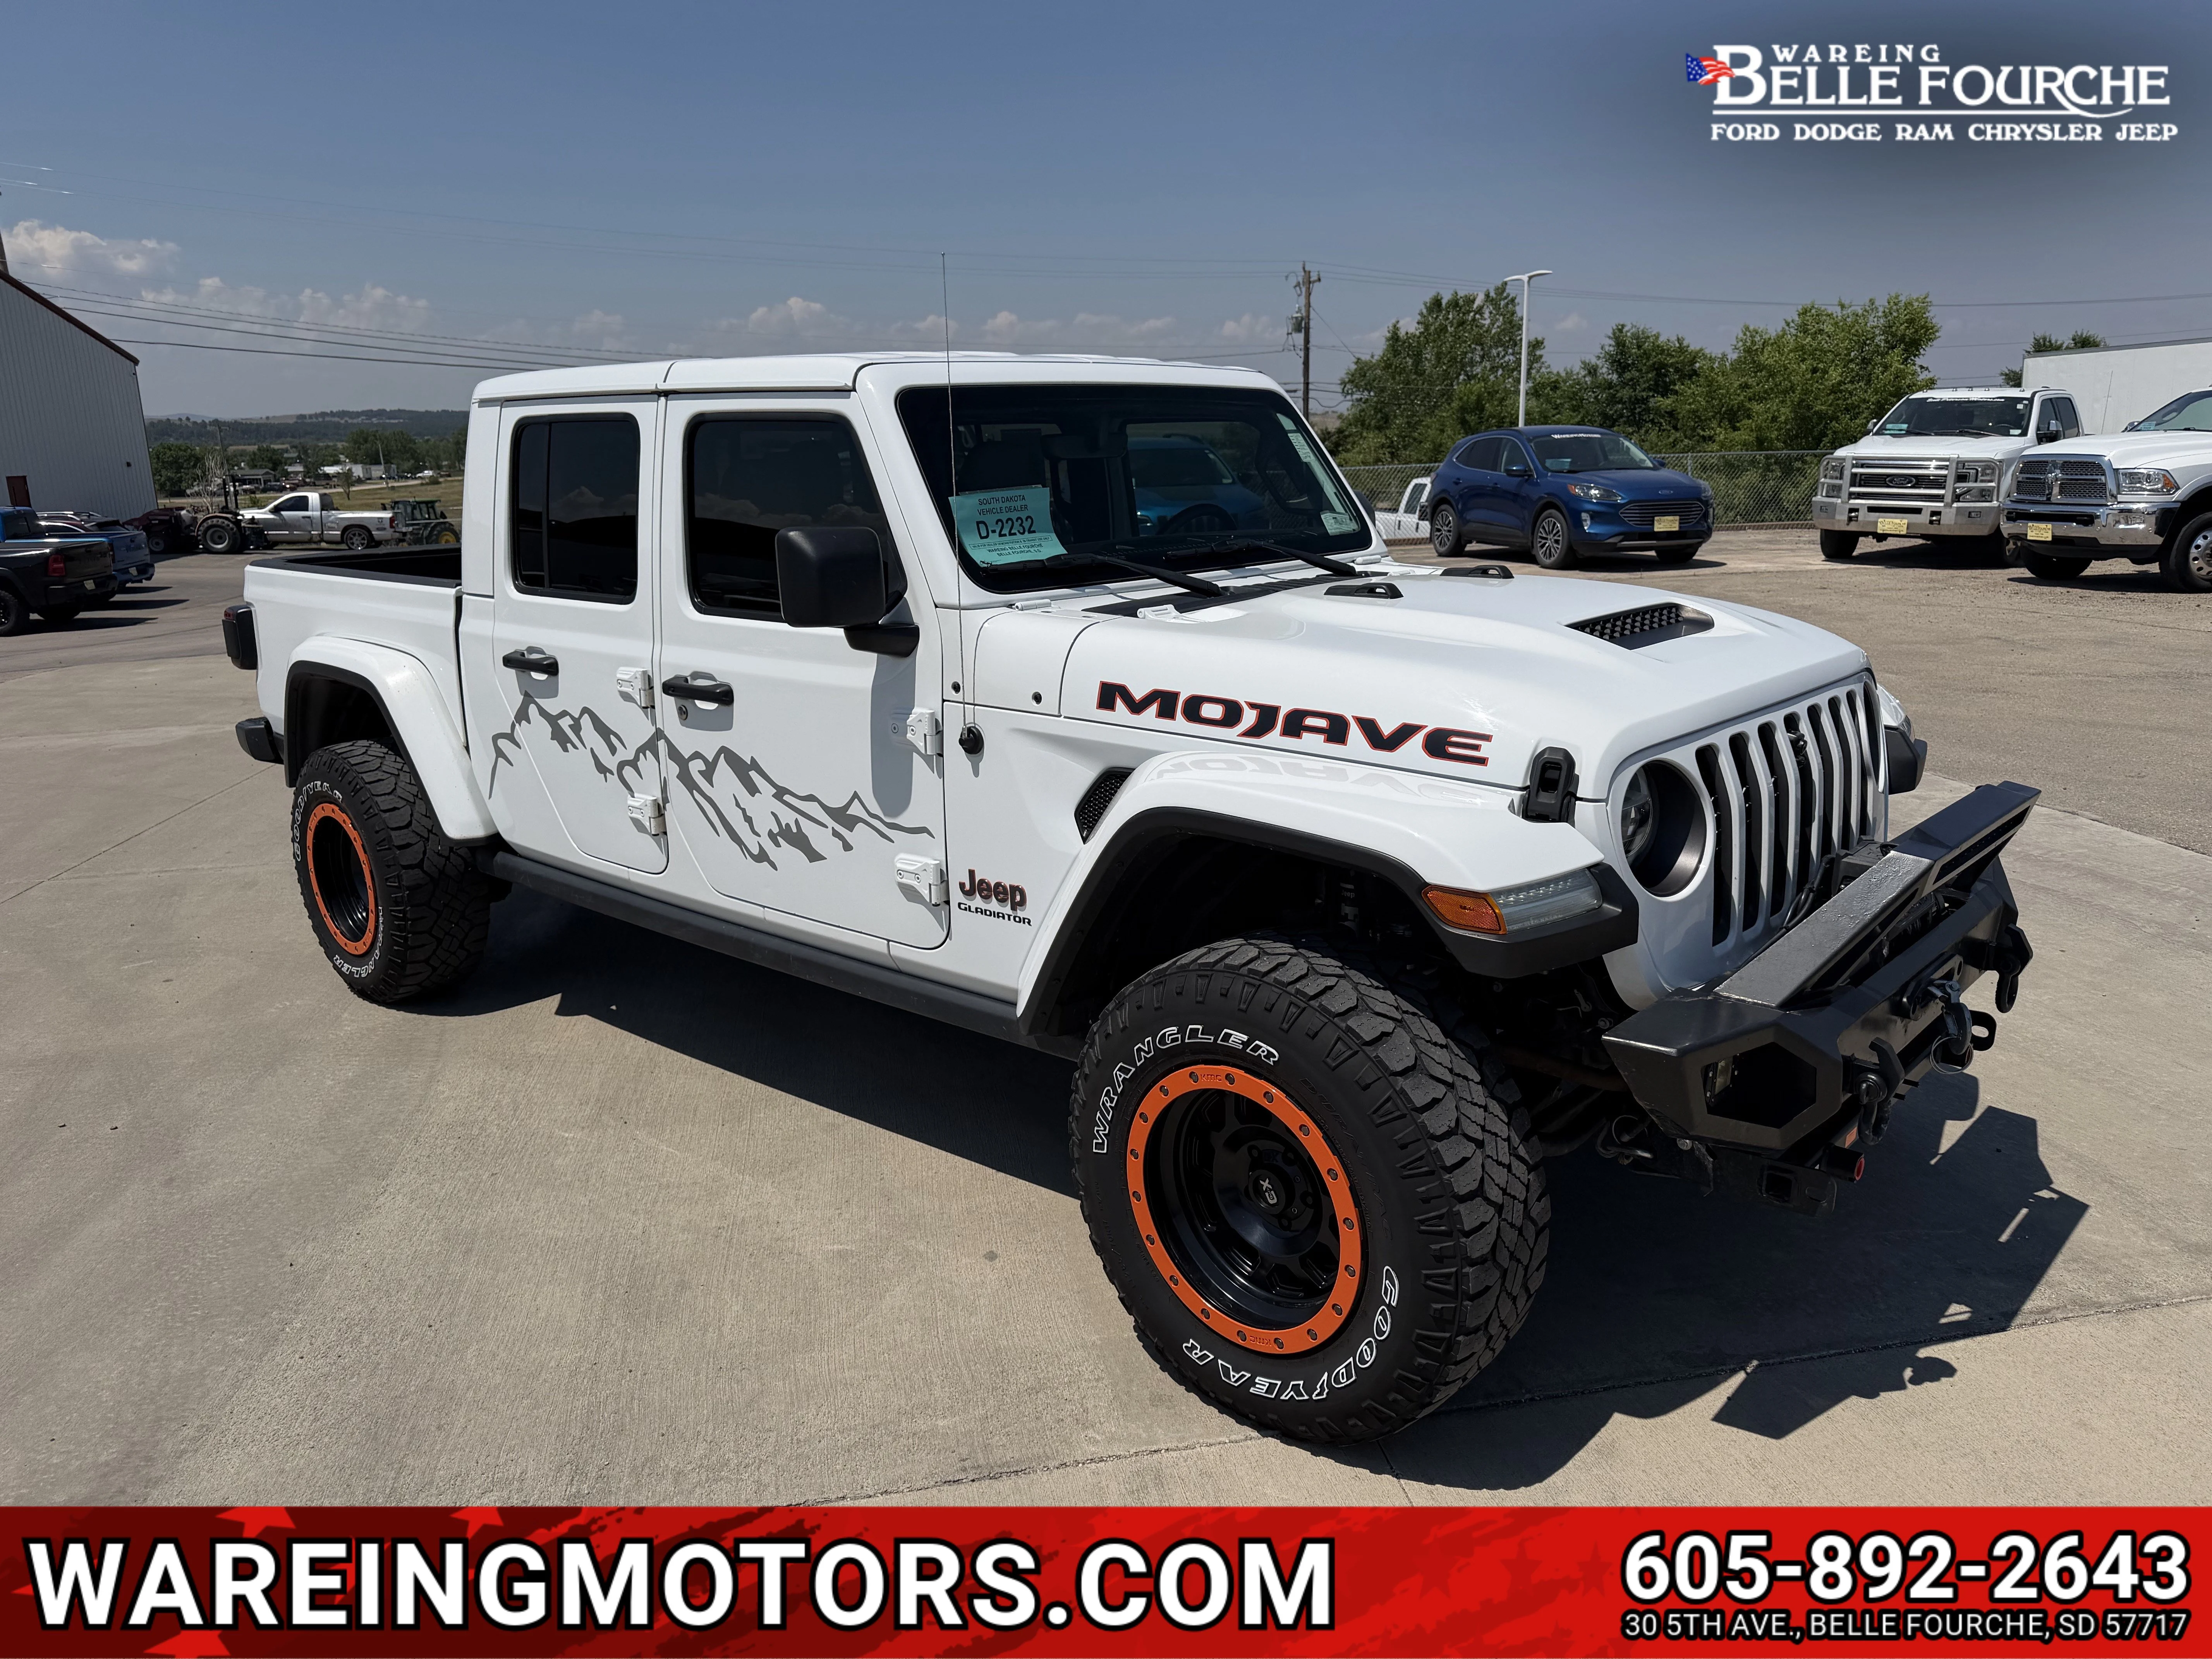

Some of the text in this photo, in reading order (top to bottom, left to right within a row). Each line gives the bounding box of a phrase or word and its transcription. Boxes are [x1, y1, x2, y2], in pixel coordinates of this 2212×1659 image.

[977, 504, 1029, 515] VEHICLE DEALER
[978, 495, 1026, 505] SOUTH DAKOTA
[976, 515, 1036, 539] D-2232
[1096, 680, 1492, 766] MOJAVE
[294, 781, 342, 862] GOODYEAR
[959, 869, 1027, 911] Jeep
[958, 902, 1032, 926] GLADIATOR
[1093, 1025, 1279, 1153] WRANGLER
[1183, 1266, 1400, 1400] GOODYEAR
